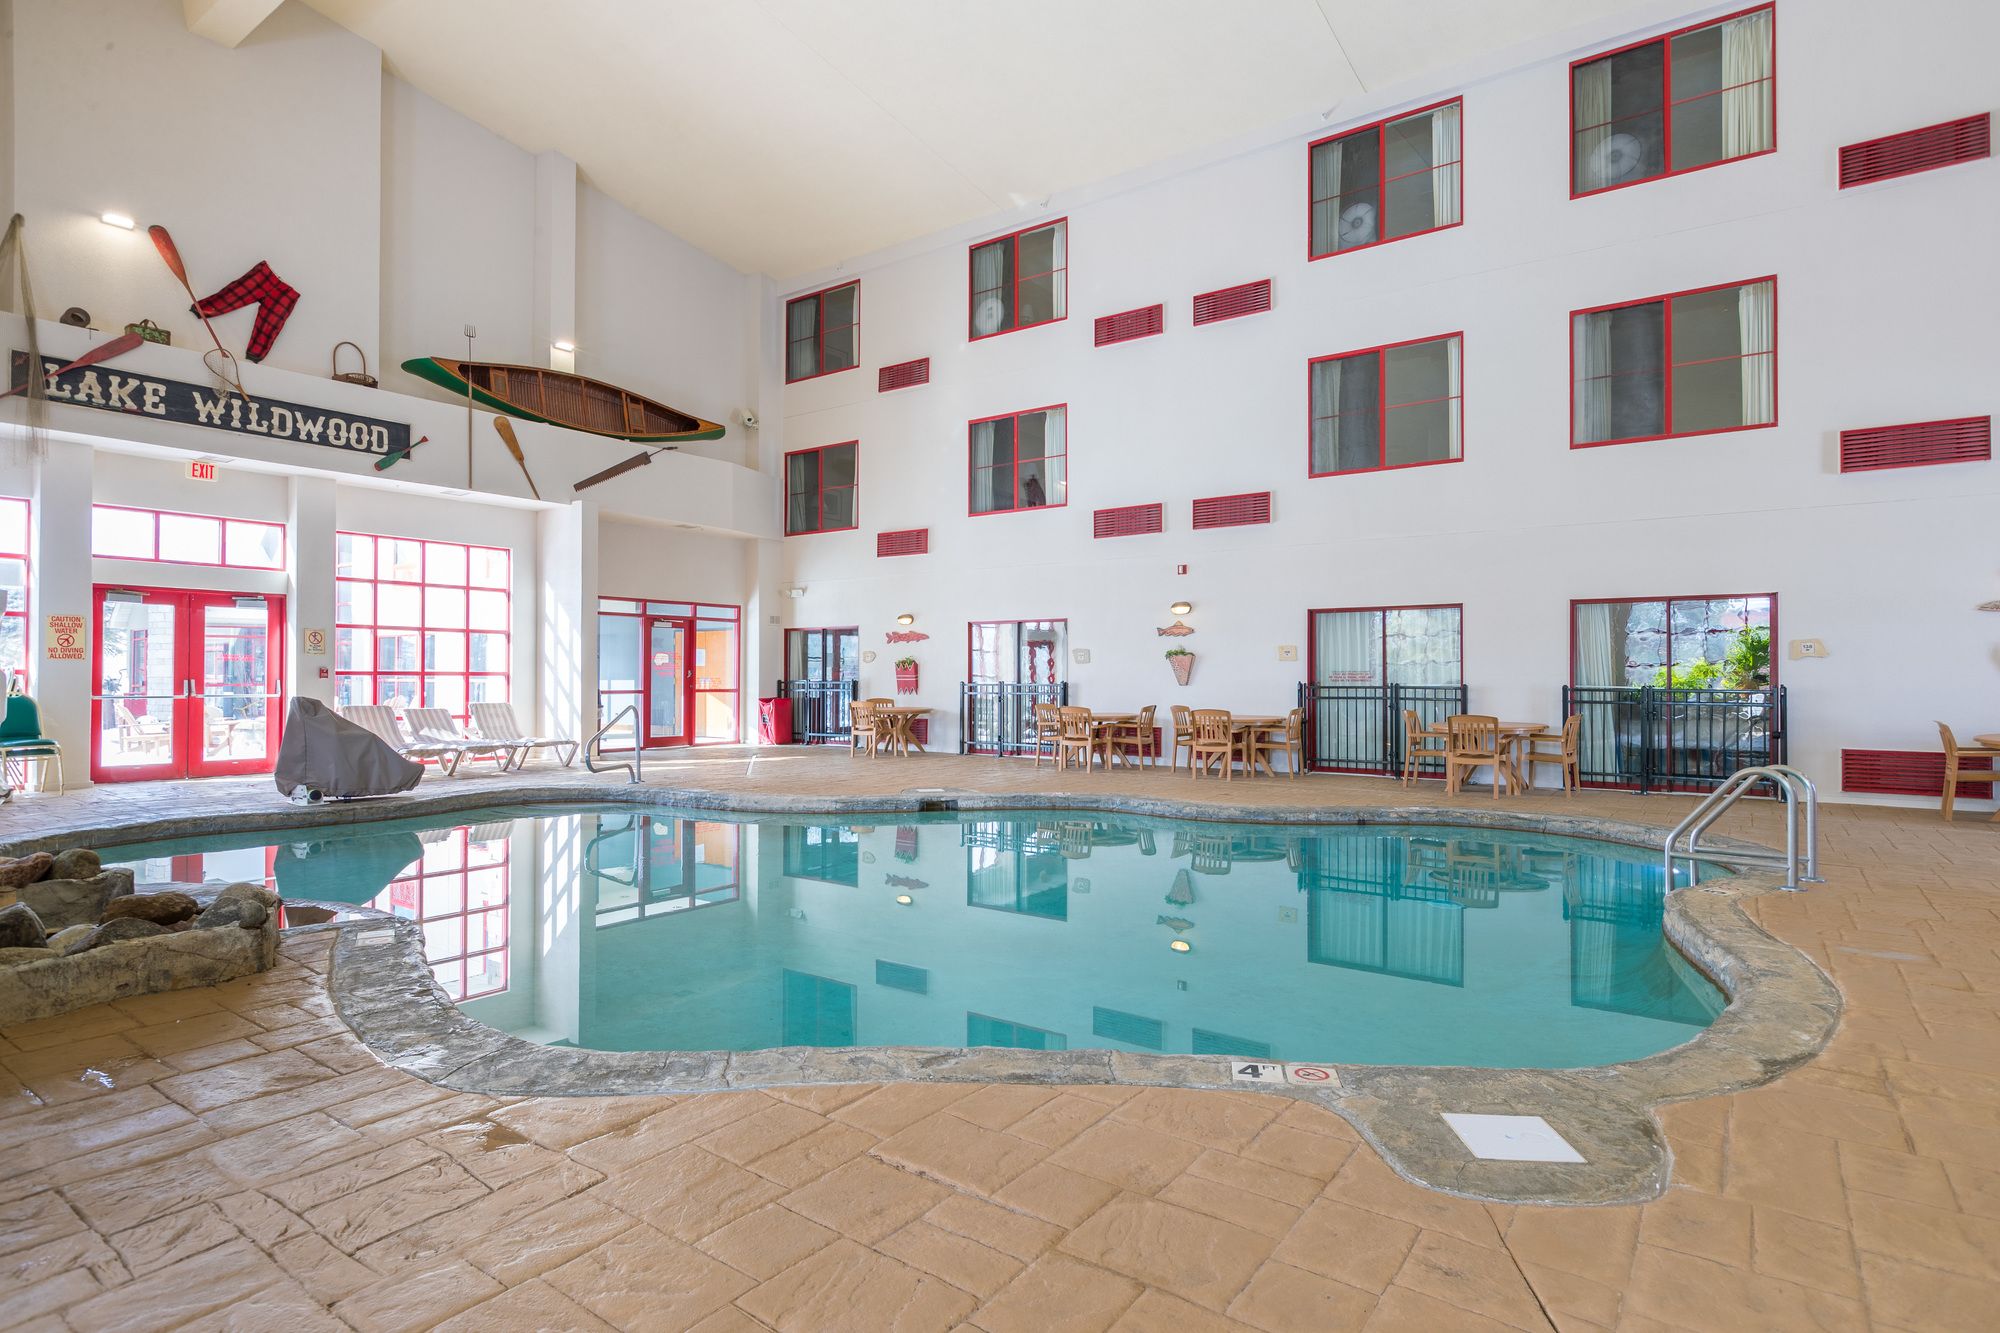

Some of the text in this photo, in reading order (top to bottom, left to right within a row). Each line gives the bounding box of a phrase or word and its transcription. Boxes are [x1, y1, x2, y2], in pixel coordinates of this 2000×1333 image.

[44, 363, 389, 453] LAKE WILDWOOD
[192, 462, 215, 480] EXIT
[1237, 1064, 1263, 1079] 4
